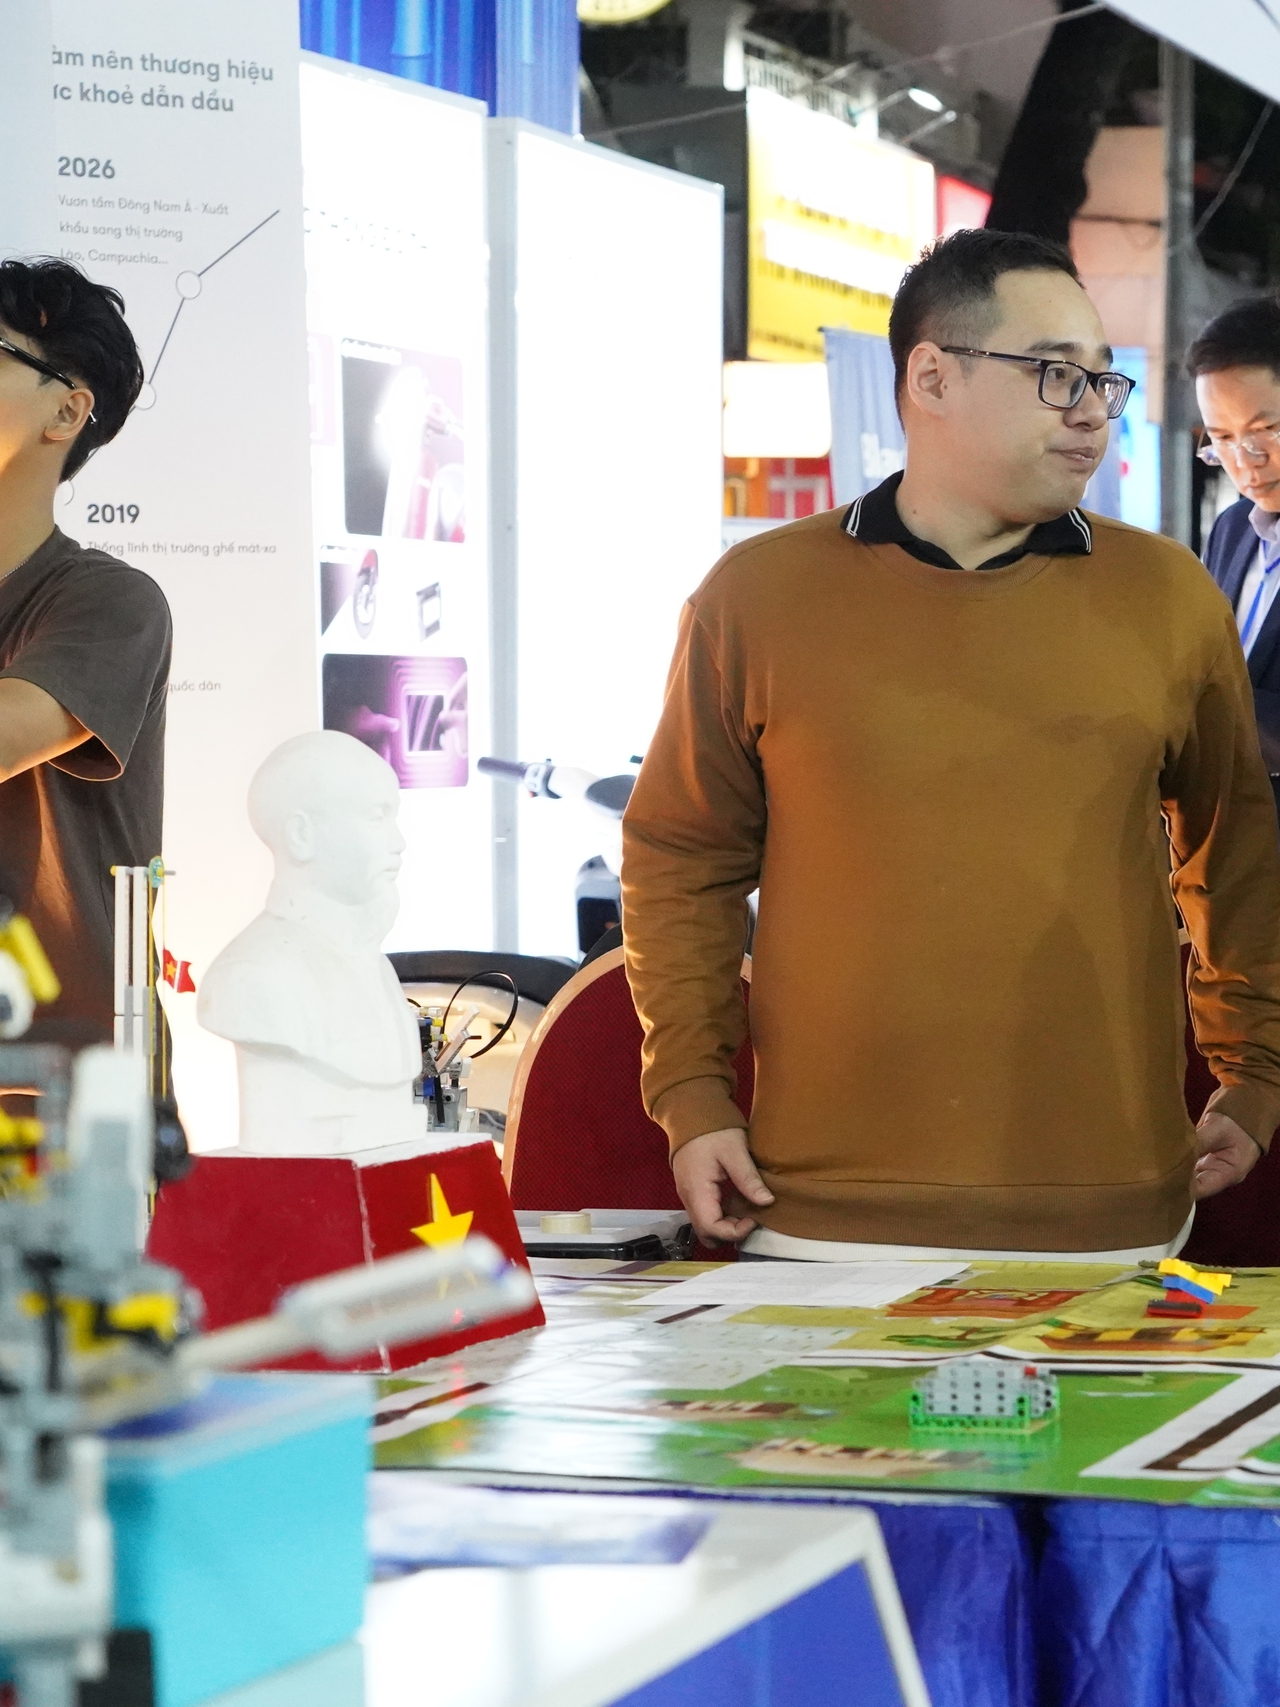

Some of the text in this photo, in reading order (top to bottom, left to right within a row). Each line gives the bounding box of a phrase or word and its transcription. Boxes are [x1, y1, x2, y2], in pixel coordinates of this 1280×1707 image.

[92, 51, 133, 70] nên
[140, 53, 220, 82] thương
[227, 58, 274, 85] hiệu
[80, 82, 134, 105] khoẻ
[141, 84, 184, 108] dẫn
[58, 156, 116, 179] 2026
[153, 199, 181, 213] Nam
[92, 225, 122, 239] sang
[125, 224, 141, 239] thị
[87, 503, 140, 524] 2019
[153, 541, 167, 556] thị
[171, 542, 209, 556] trường
[212, 540, 235, 556] ghế
[198, 680, 221, 691] dân
